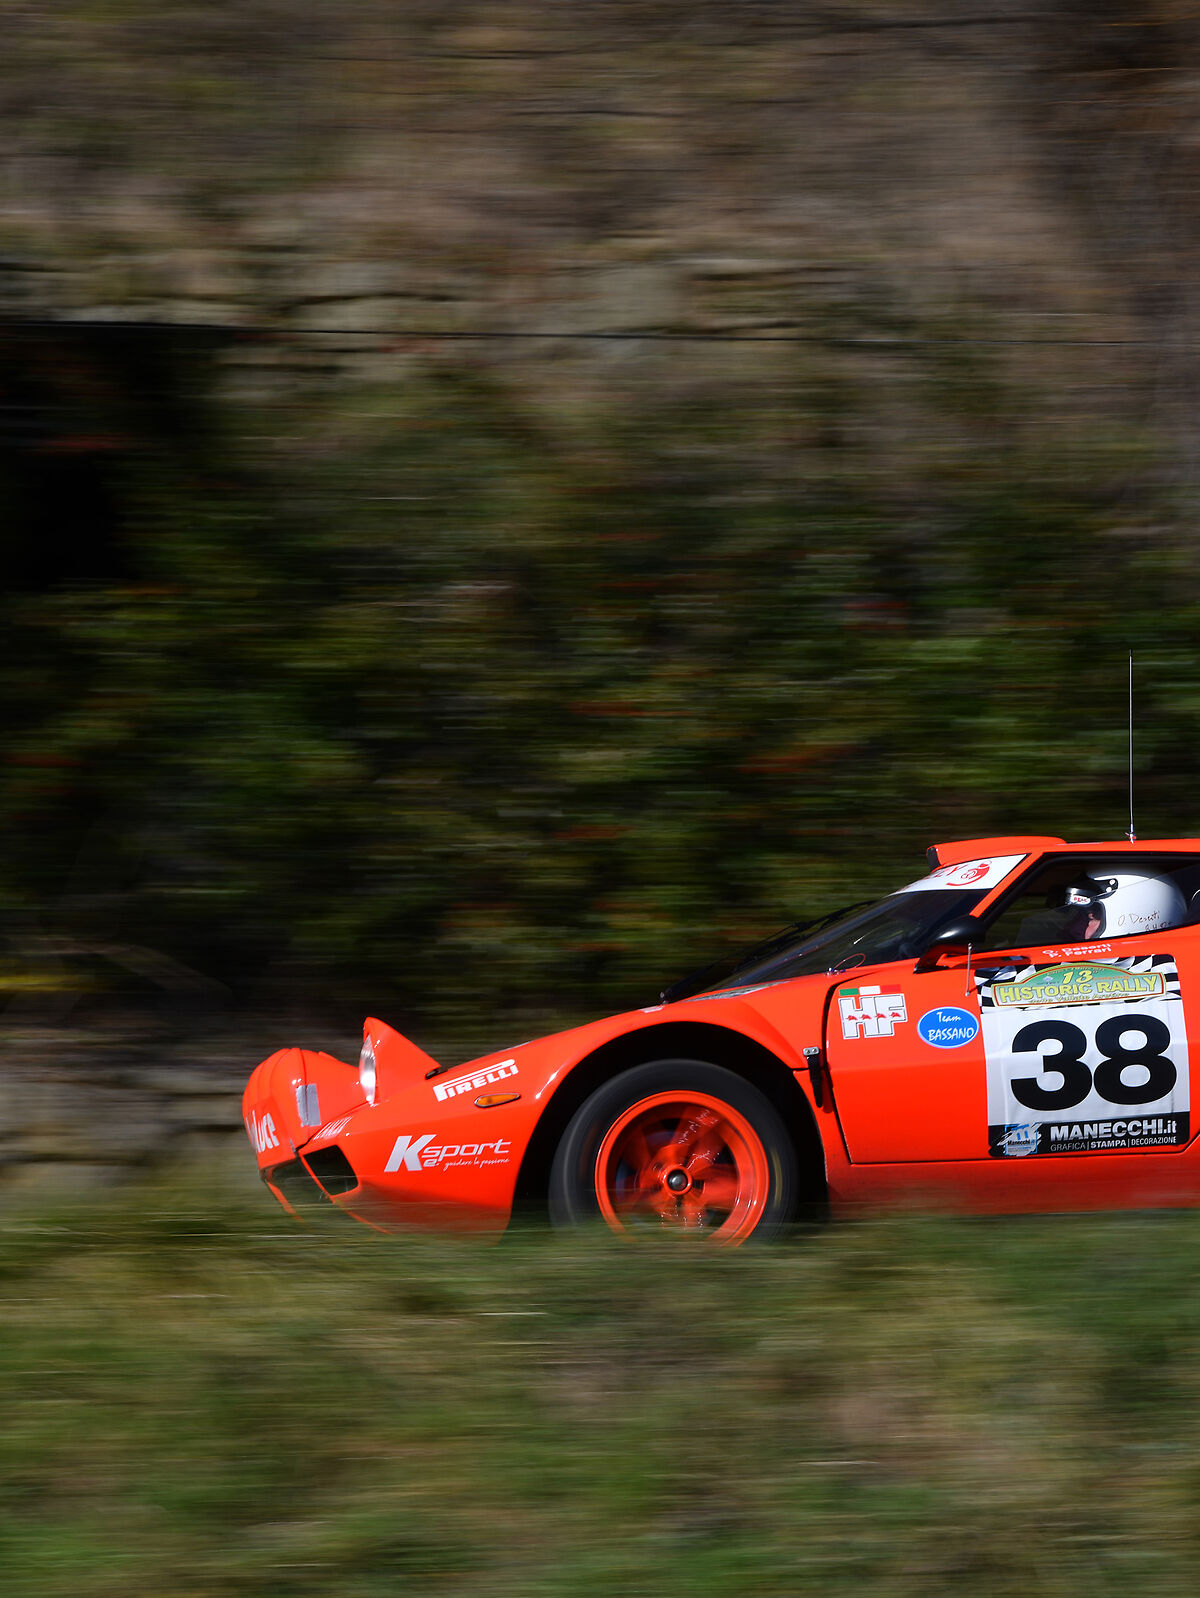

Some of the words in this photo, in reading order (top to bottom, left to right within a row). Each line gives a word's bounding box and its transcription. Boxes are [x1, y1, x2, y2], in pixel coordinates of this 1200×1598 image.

[1000, 983, 1092, 1003] HISTORIC
[1097, 975, 1157, 994] RALLY
[838, 993, 908, 1039] HF
[936, 1011, 962, 1022] Team
[928, 1027, 975, 1042] BASSANO
[1011, 1014, 1177, 1111] 38
[433, 1059, 519, 1102] PIRELLI
[1050, 1118, 1177, 1142] MANECCHI.it
[1050, 1142, 1086, 1152] GRAFICA
[1090, 1140, 1127, 1149] STAMPA
[1131, 1136, 1177, 1146] DECORAZIONE
